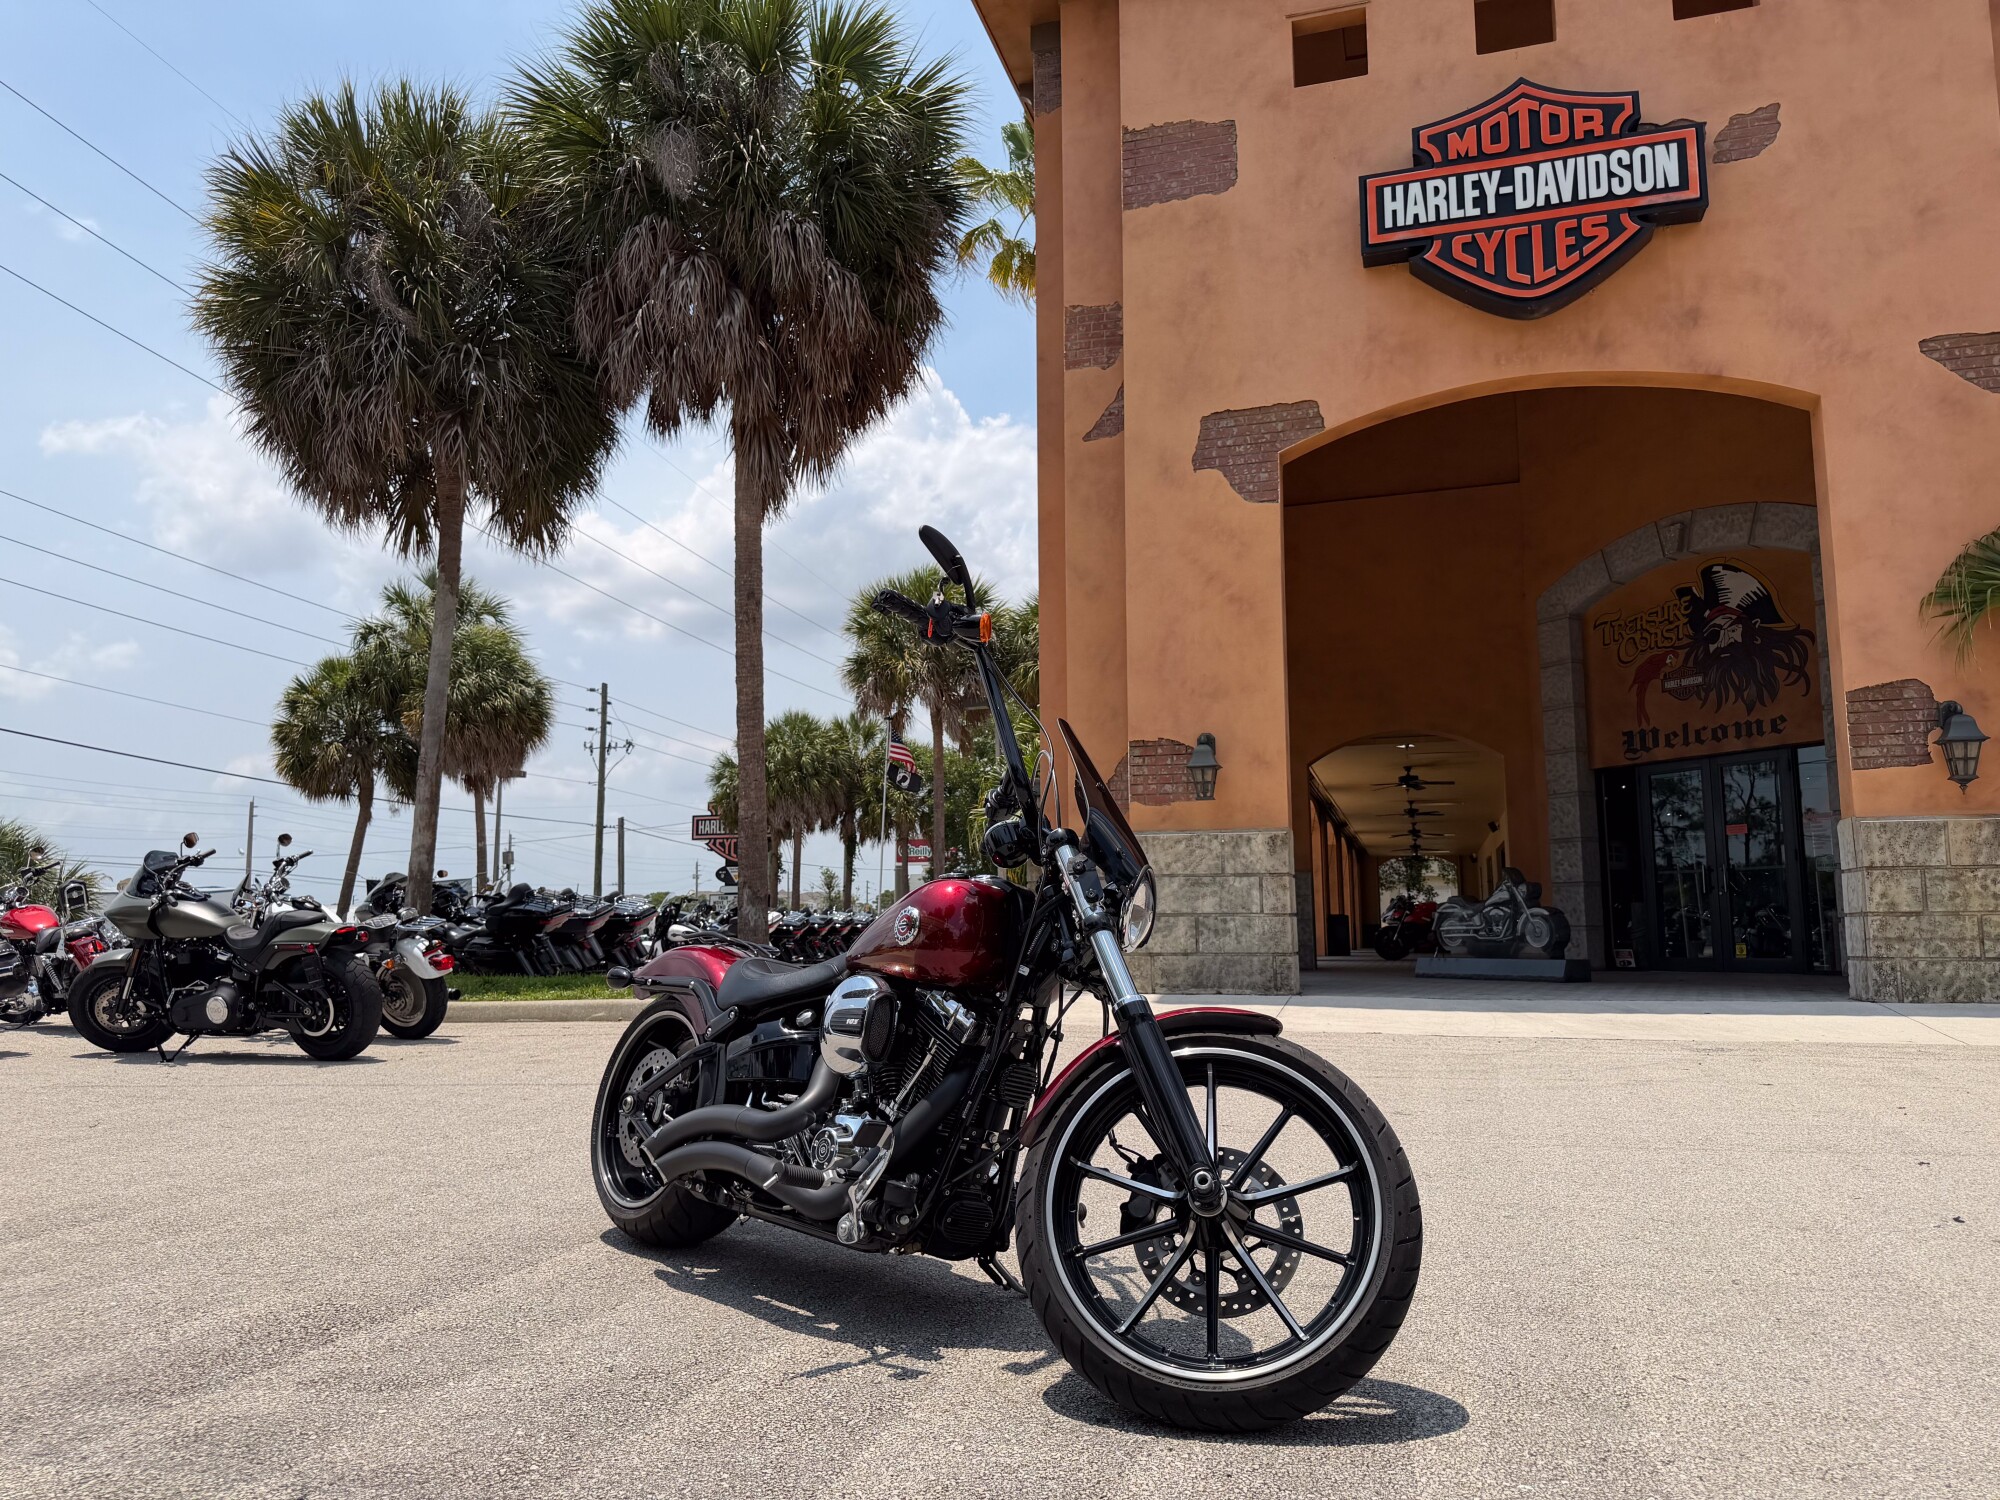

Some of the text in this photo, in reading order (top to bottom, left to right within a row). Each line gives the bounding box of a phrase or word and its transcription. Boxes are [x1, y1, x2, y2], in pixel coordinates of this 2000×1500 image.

[1447, 98, 1604, 160] MOTOR
[1383, 142, 1680, 229] HARLEY-DAVIDSON
[1451, 214, 1609, 285] CYCLES
[1594, 595, 1693, 647] TREASURE
[1622, 714, 1788, 760] Welcome
